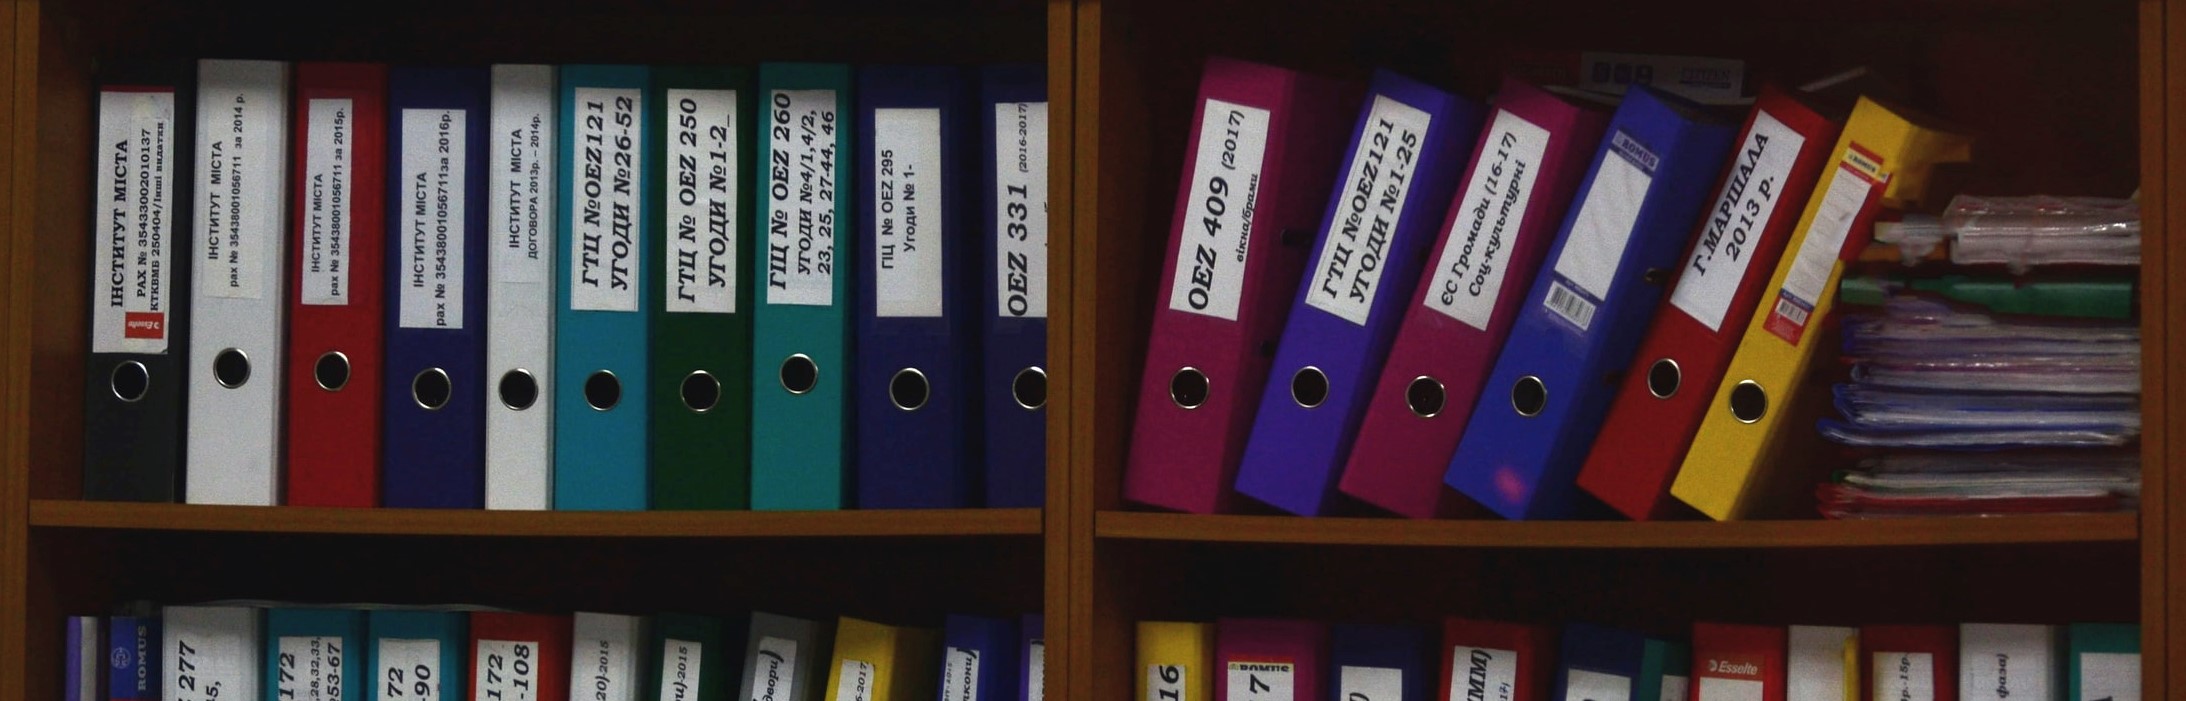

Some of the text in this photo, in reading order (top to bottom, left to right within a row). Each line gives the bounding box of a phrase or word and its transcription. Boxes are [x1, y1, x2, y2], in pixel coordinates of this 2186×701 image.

[232, 107, 243, 133] 2014
[234, 136, 243, 150] за
[438, 111, 452, 153] 2016р.
[531, 113, 542, 147] 2014р.
[773, 92, 791, 143] 260
[137, 128, 151, 298] РАХ № 35433002010137
[208, 140, 222, 260] ІНСТИТУТ МІСТА
[229, 156, 242, 247] 35438001056711
[330, 107, 345, 297] рах № 35438001056711 за 2015р.
[509, 129, 522, 249] ІНСТИТУТ МІСТА
[529, 160, 541, 194] 2013р.
[582, 101, 604, 287] ГТЦ №OEZ121
[610, 96, 633, 291] УГОДИ №26-52
[678, 98, 698, 303] ГТЦ № OEZ 250
[772, 149, 790, 202] OEZ
[817, 111, 836, 275] 23, 25, 27-44, 46
[881, 149, 896, 269] ГІЦ № OEZ 295
[903, 164, 917, 253] Угоди № 1-
[1007, 102, 1030, 317] OEZ 331 (2016-2017)
[1188, 109, 1245, 310] OEZ 409 (2017)
[1235, 173, 1258, 263] вікна/брами
[1322, 118, 1394, 299] ГТЦ №OEZ121
[1349, 129, 1416, 303] УГОДИ №1-25
[1441, 131, 1517, 306] ЄС Громади (16-17)
[1725, 175, 1775, 262] 2013 р.
[110, 139, 128, 308] ІНСТИТУТ МІСТА
[229, 250, 239, 264] №
[311, 174, 323, 273] ІНСТИТУТ МІСТА
[413, 172, 427, 288] ІНСТИТУТ МІСТА
[528, 197, 540, 260] ДОГОВОРА
[709, 198, 729, 288] УГОДИ
[771, 208, 788, 239] №
[797, 208, 814, 275] УГОДИ
[1468, 159, 1526, 297] Соц-культурні
[229, 267, 240, 288] рах
[434, 284, 445, 299] №
[435, 303, 447, 327] рах
[137, 624, 147, 691] ROMUS
[178, 639, 196, 692] 277
[279, 653, 295, 700] 172
[387, 667, 404, 698] 72
[487, 653, 503, 701] 172
[513, 644, 530, 700] -108
[1159, 665, 1179, 701] 16
[1996, 653, 2010, 699] фаза)
